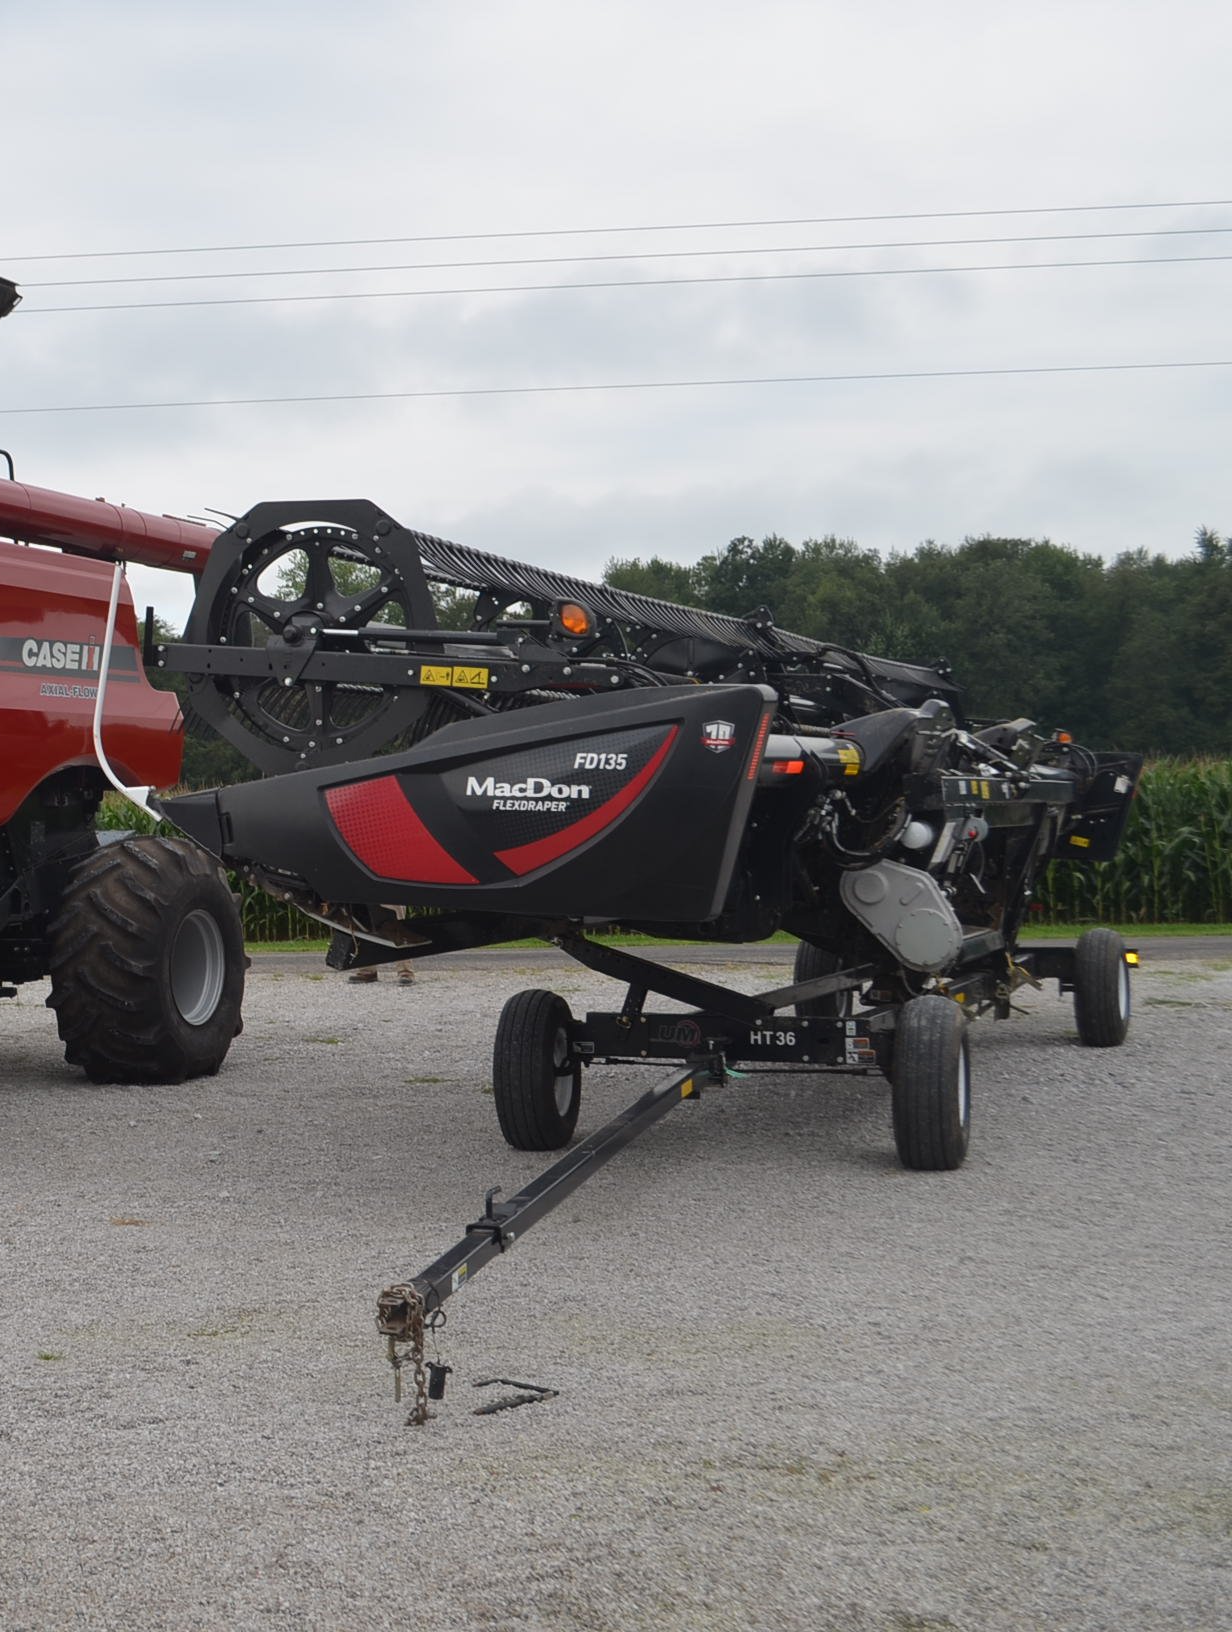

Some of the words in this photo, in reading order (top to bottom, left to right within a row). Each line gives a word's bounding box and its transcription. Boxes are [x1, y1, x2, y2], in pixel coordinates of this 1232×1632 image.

[22, 639, 81, 670] CASE
[574, 753, 628, 770] FD135
[466, 776, 591, 799] MacDon
[493, 800, 567, 812] FLEXDRAPER
